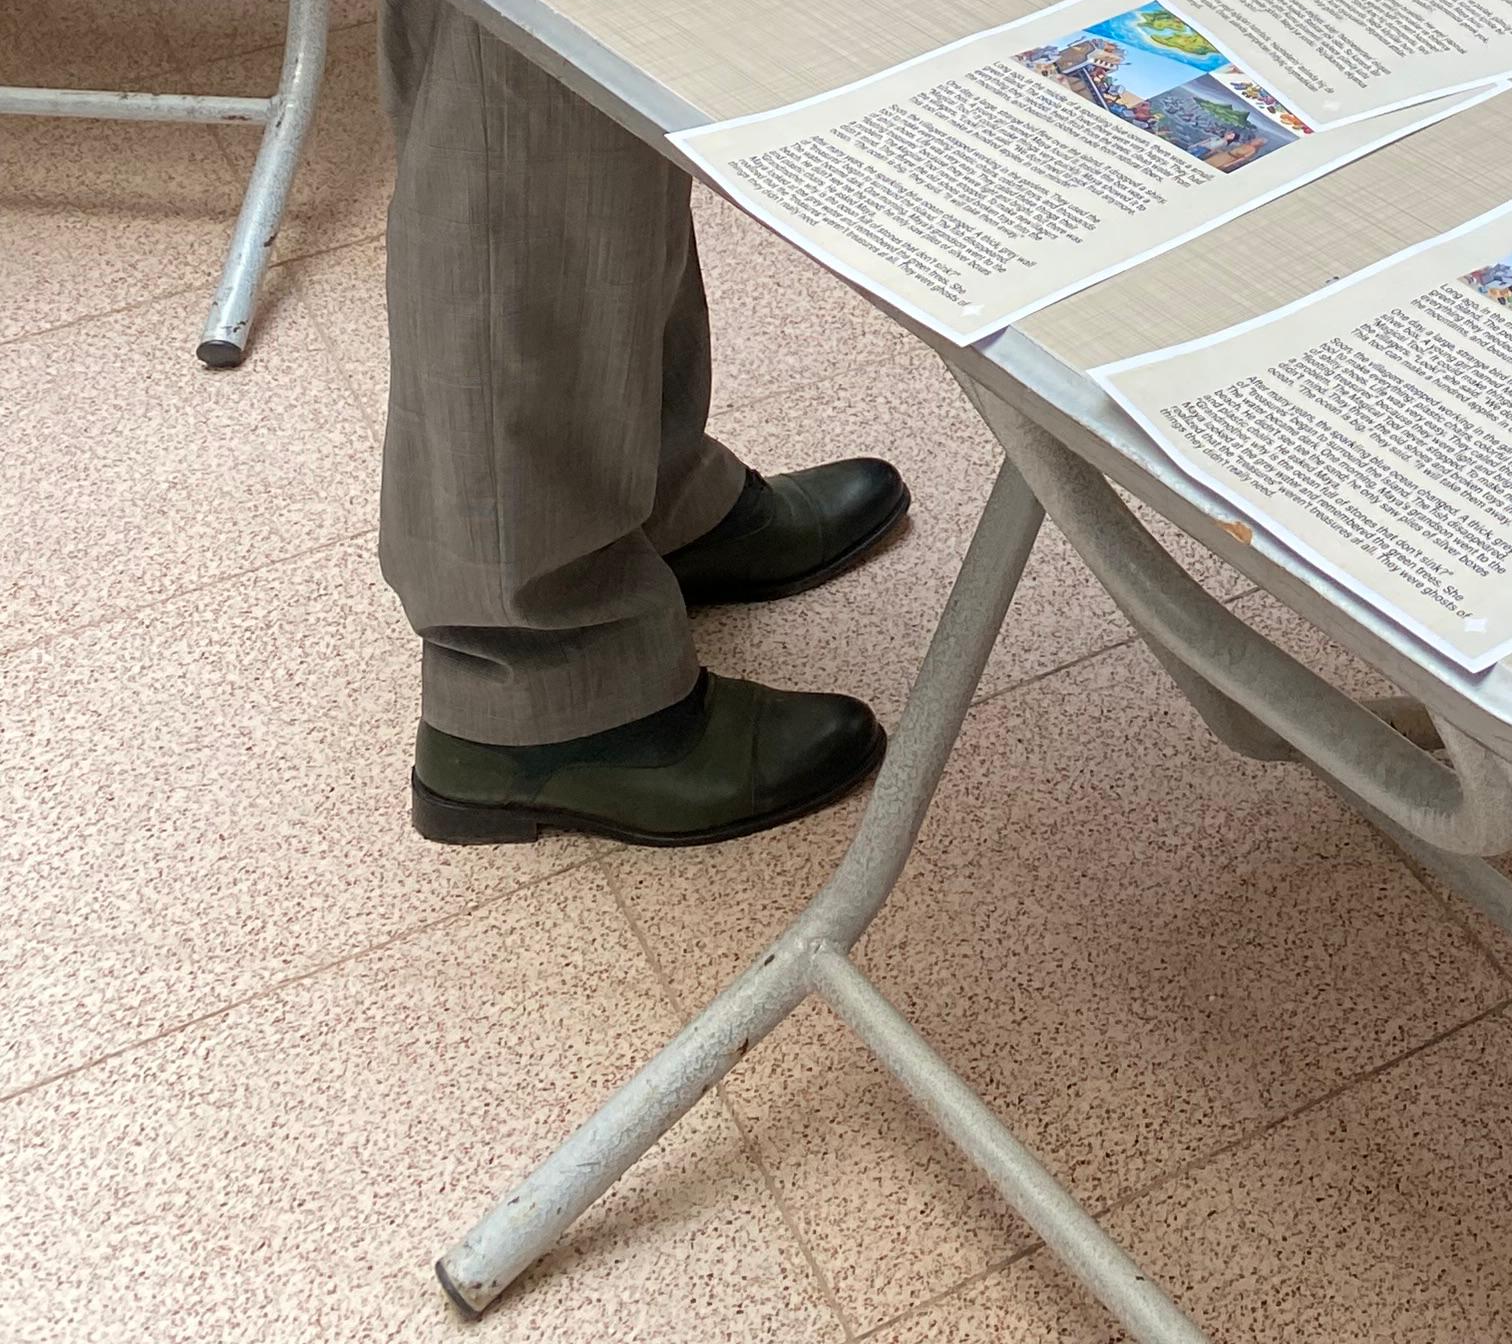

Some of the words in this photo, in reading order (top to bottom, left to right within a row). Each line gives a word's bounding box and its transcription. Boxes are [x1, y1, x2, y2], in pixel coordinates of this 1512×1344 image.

[1390, 308, 1410, 321] One
[1456, 349, 1490, 370] strange
[1488, 367, 1511, 381] bird
[1428, 289, 1456, 306] green
[1483, 318, 1501, 332] The
[1334, 497, 1351, 506] of
[1345, 505, 1378, 529] stones
[1376, 526, 1399, 541] that
[1395, 539, 1423, 558] don't
[1347, 479, 1362, 490] he
[1359, 488, 1381, 505] only
[1379, 503, 1401, 517] saw
[1397, 513, 1424, 532] piles
[1421, 530, 1438, 539] of
[1432, 537, 1461, 556] silver
[1458, 554, 1490, 577] boxes
[1378, 487, 1411, 511] Maya's
[1407, 509, 1454, 541] grandson
[1452, 537, 1479, 555] went
[1476, 552, 1489, 563] to
[1488, 560, 1506, 574] the
[1411, 496, 1431, 510] The
[1429, 506, 1449, 522] fish
[1447, 520, 1507, 562] disappeared.
[1417, 489, 1460, 516] changed.
[1458, 514, 1470, 523] A
[1309, 506, 1352, 538] treasures
[1350, 537, 1365, 545] at
[1360, 543, 1377, 556] all.
[1376, 552, 1401, 572] They
[1399, 570, 1425, 589] were
[1420, 587, 1457, 611] ghosts
[1455, 610, 1473, 619] of
[1317, 499, 1375, 539] remembered
[1372, 536, 1390, 550] the
[1386, 548, 1417, 569] green
[1415, 566, 1442, 588] trees.
[1442, 585, 1464, 602] She
